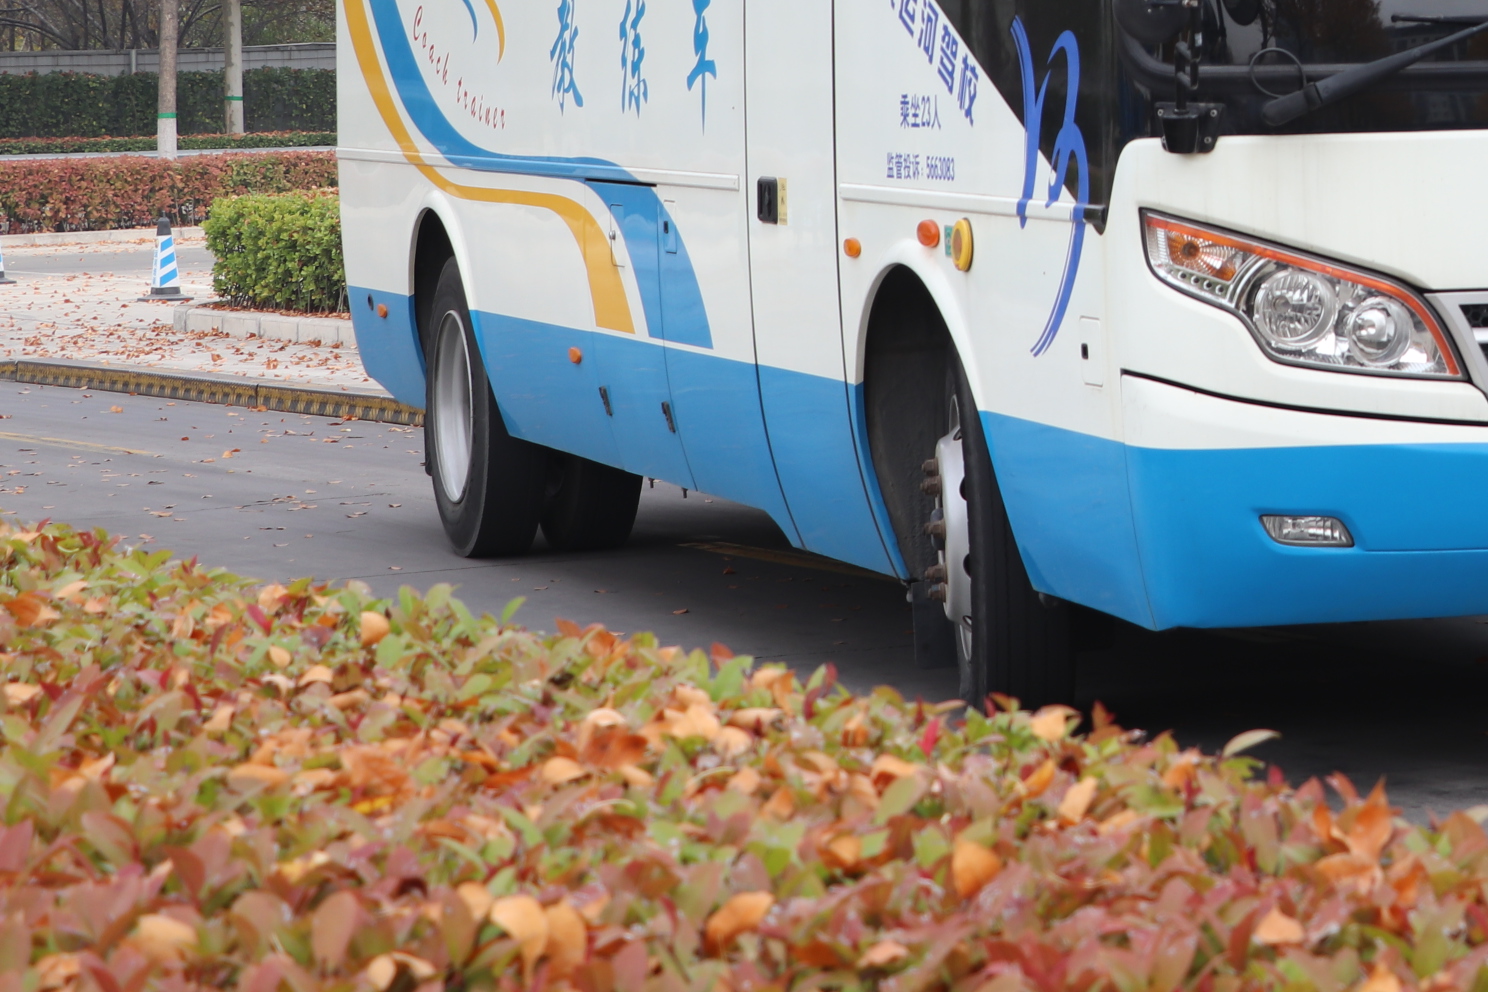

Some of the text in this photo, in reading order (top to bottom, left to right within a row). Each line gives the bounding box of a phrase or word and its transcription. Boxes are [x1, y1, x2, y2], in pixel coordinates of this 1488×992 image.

[413, 4, 506, 130] Coach trainer
[899, 94, 942, 130] 乘坐23人
